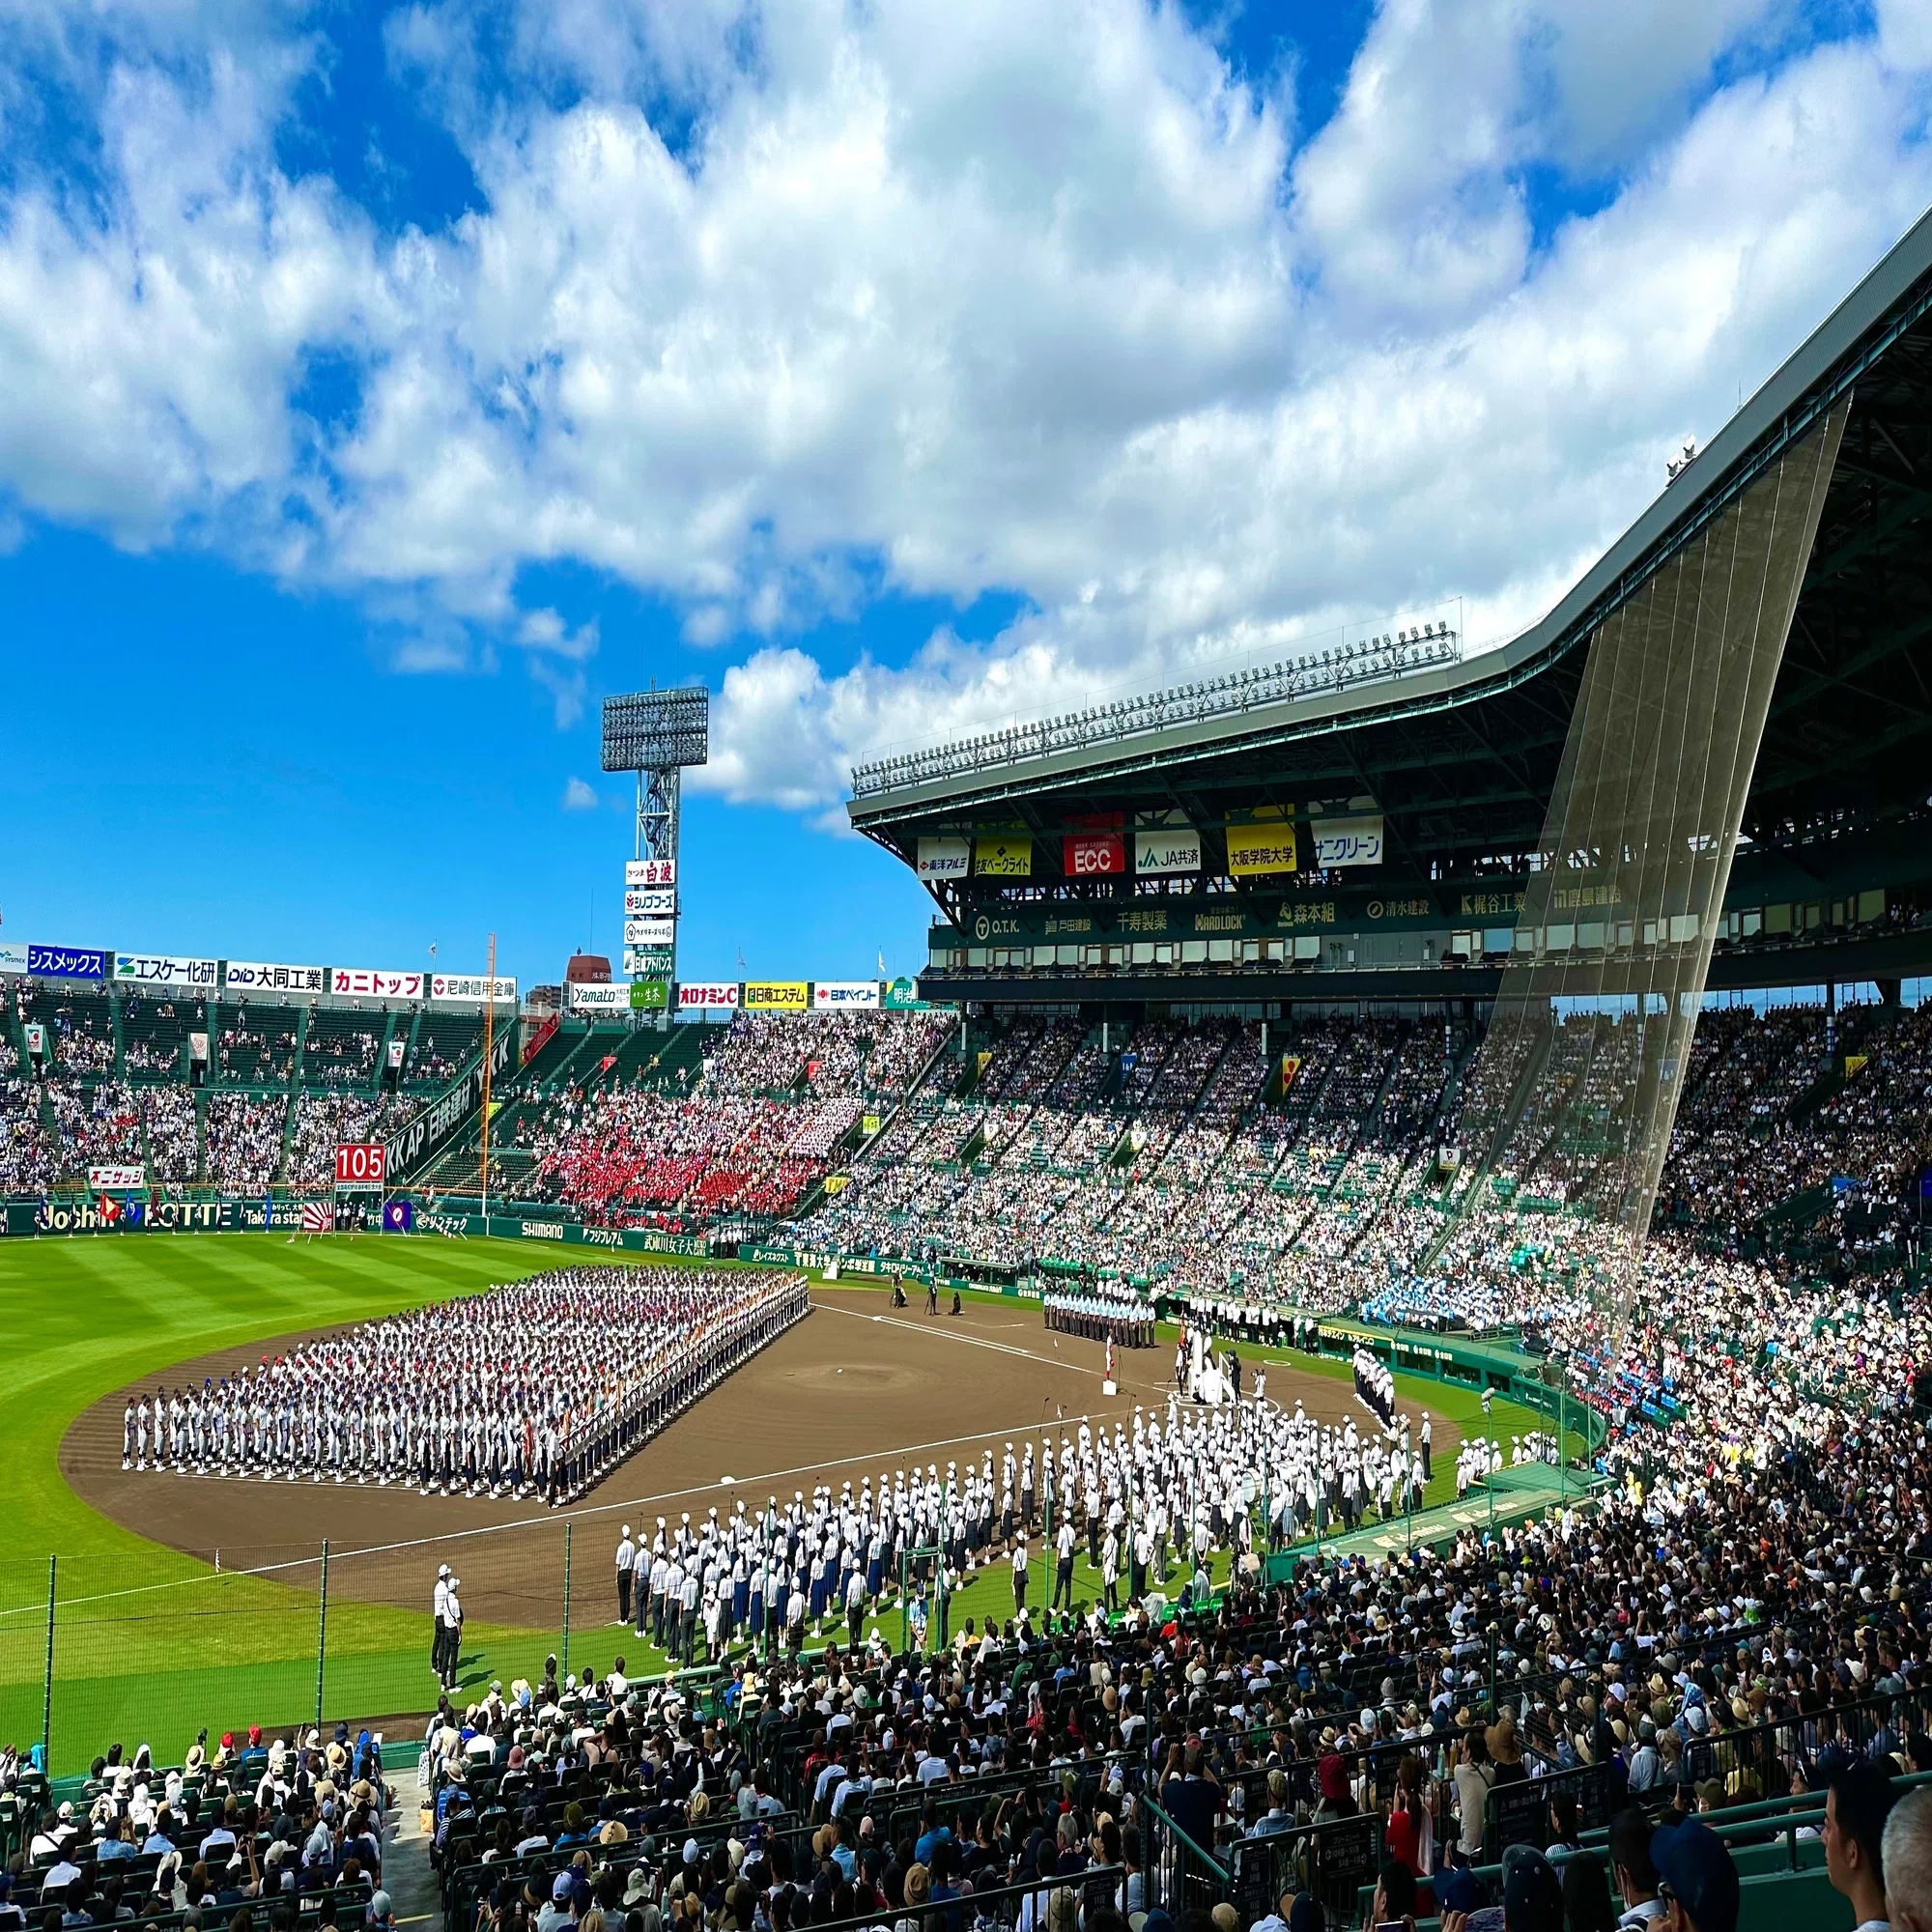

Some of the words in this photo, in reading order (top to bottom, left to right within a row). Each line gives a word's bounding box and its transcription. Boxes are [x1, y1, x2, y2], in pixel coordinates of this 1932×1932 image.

[929, 858, 966, 870] 東洋アルミ
[1074, 849, 1111, 872] ECC
[1160, 849, 1199, 867] JA共済
[1231, 845, 1293, 867] 大阪学院大学
[646, 862, 672, 883] 白波
[635, 895, 673, 909] シノブフーズ
[1474, 893, 1525, 914] 梶谷工業
[1568, 888, 1622, 908] 鹿島建設
[1293, 902, 1335, 924] 森本組
[1386, 899, 1429, 917] 清水建設
[992, 921, 1020, 934] O.T.K.
[1059, 919, 1092, 932] 戸田建設
[1117, 910, 1167, 932] 千寿製薬
[1195, 914, 1242, 931] HARDLOCK
[30, 951, 101, 974] シスメックス
[135, 959, 215, 983] エスケー化研
[257, 968, 322, 991] 大同工業
[335, 972, 421, 995] カニトップ
[447, 980, 515, 997] 尼崎信用金庫
[574, 988, 615, 1003] Yamato
[645, 987, 661, 1002] 生茶
[680, 987, 737, 1004] オロナミンC
[756, 986, 806, 1003] 日商エステム
[831, 989, 877, 1002] 日本ペイント
[429, 1078, 470, 1144] 日鉄建材
[339, 1148, 382, 1178] 105
[91, 1170, 143, 1184] 不二サッシ
[43, 1205, 115, 1230] Joshin
[145, 1204, 232, 1230] LOTTE
[245, 1209, 281, 1225] Takra
[522, 1222, 563, 1239] SHIMANO
[644, 1235, 694, 1256] 武庫川女子大
[758, 1252, 789, 1264] レイズネクスト
